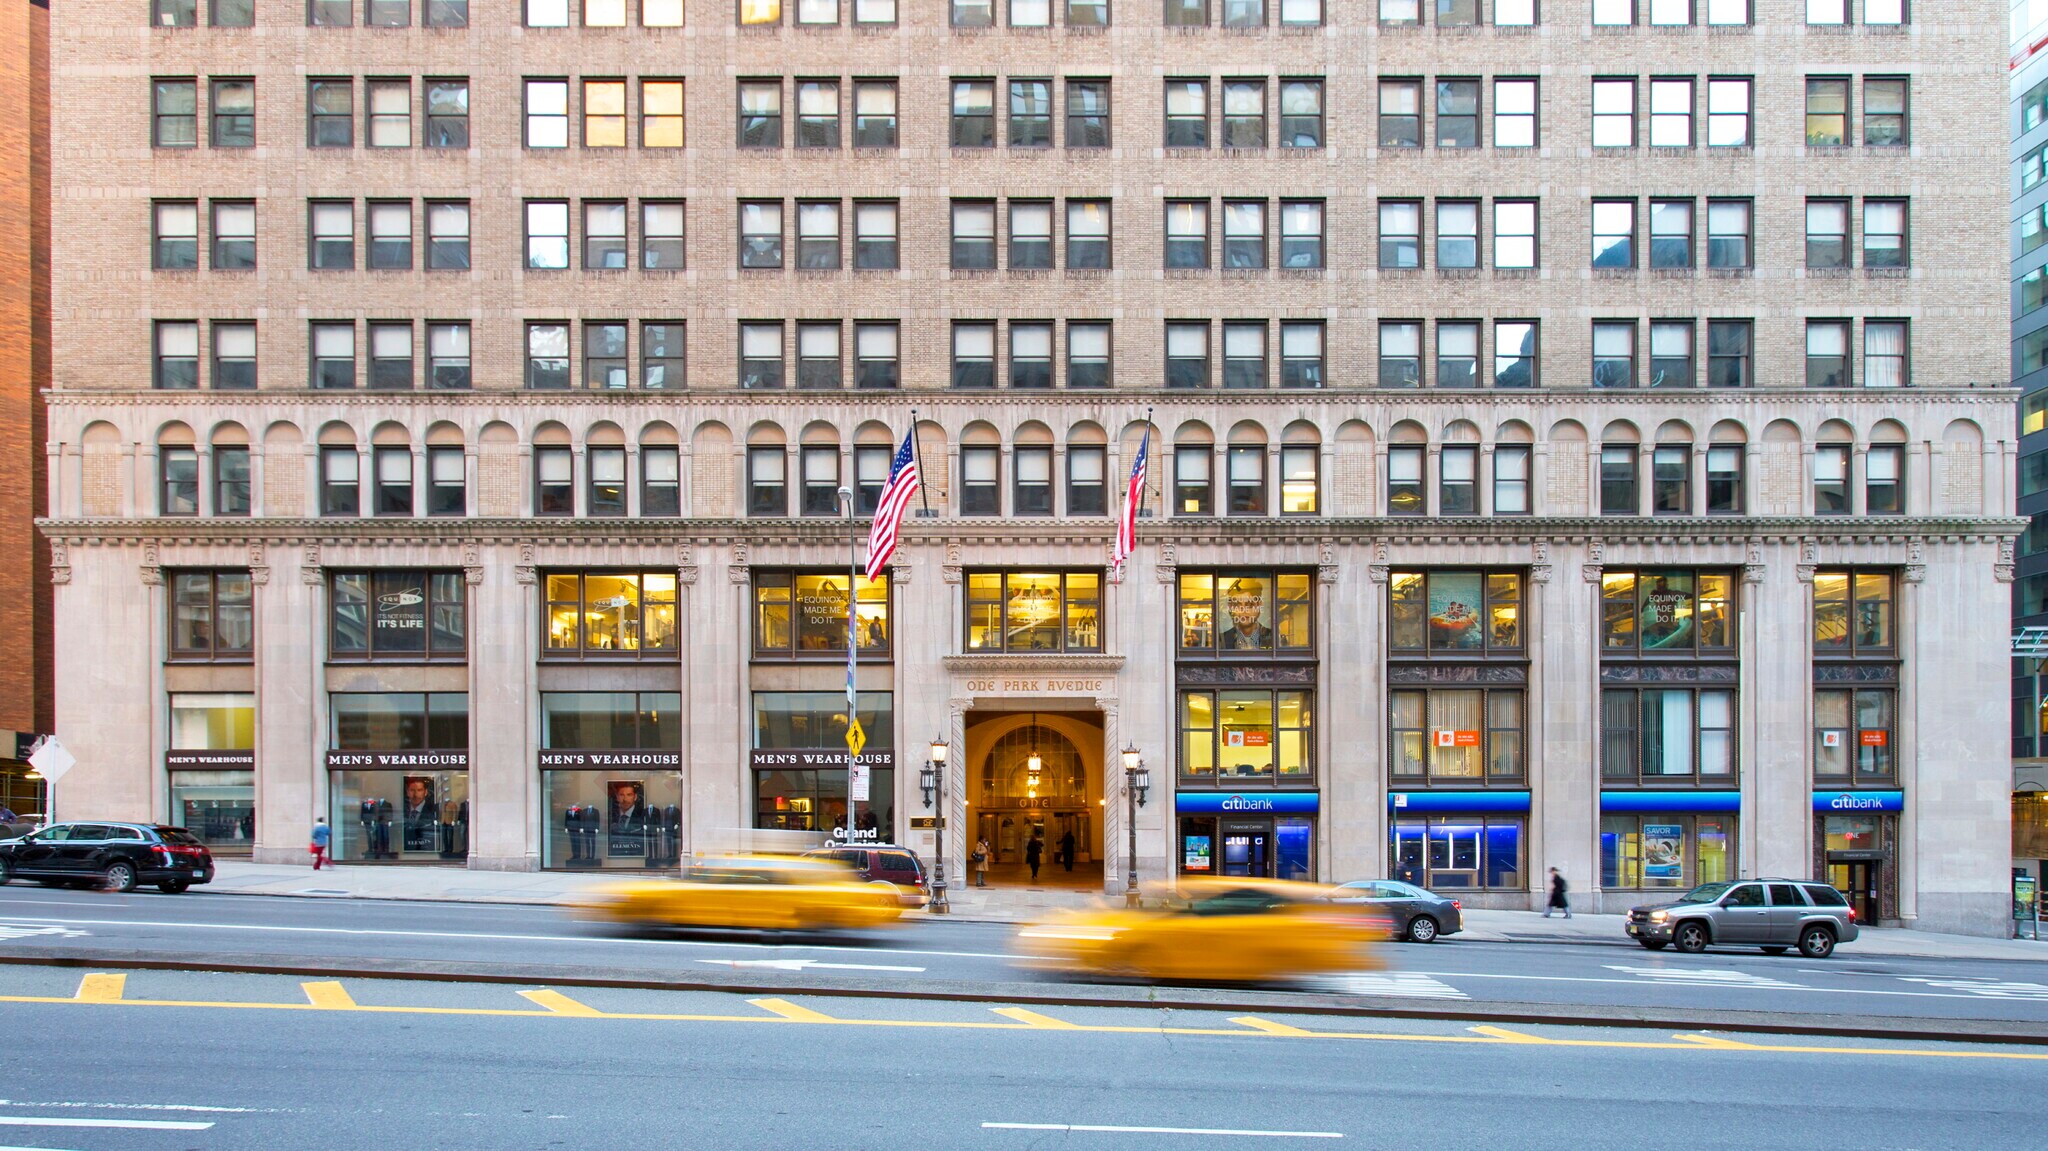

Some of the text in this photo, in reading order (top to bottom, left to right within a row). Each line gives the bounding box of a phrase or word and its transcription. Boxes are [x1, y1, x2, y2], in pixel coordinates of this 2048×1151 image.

[804, 596, 842, 604] EQUINOX
[1227, 595, 1264, 603] EQUINOX
[1648, 594, 1686, 603] EQUINOX
[804, 606, 842, 614] MADE ME
[1227, 605, 1264, 614] MADE ME
[1648, 604, 1672, 613] MADE
[811, 616, 825, 625] DO
[1233, 615, 1247, 624] DO
[1656, 614, 1669, 623] DO
[377, 619, 424, 628] IT'S LIFE
[1003, 680, 1040, 692] PARK
[1047, 680, 1103, 692] AVENUE
[168, 756, 253, 764] MEN'S WEARHOUSE
[328, 755, 467, 765] MEN'S WEARHOUSE
[541, 754, 679, 765] MEN'S WEARHOUSE
[754, 754, 891, 764] MEN'S WEARHOUSE
[1222, 795, 1273, 810] citibank
[1831, 795, 1883, 809] citibank
[833, 826, 877, 839] Grand
